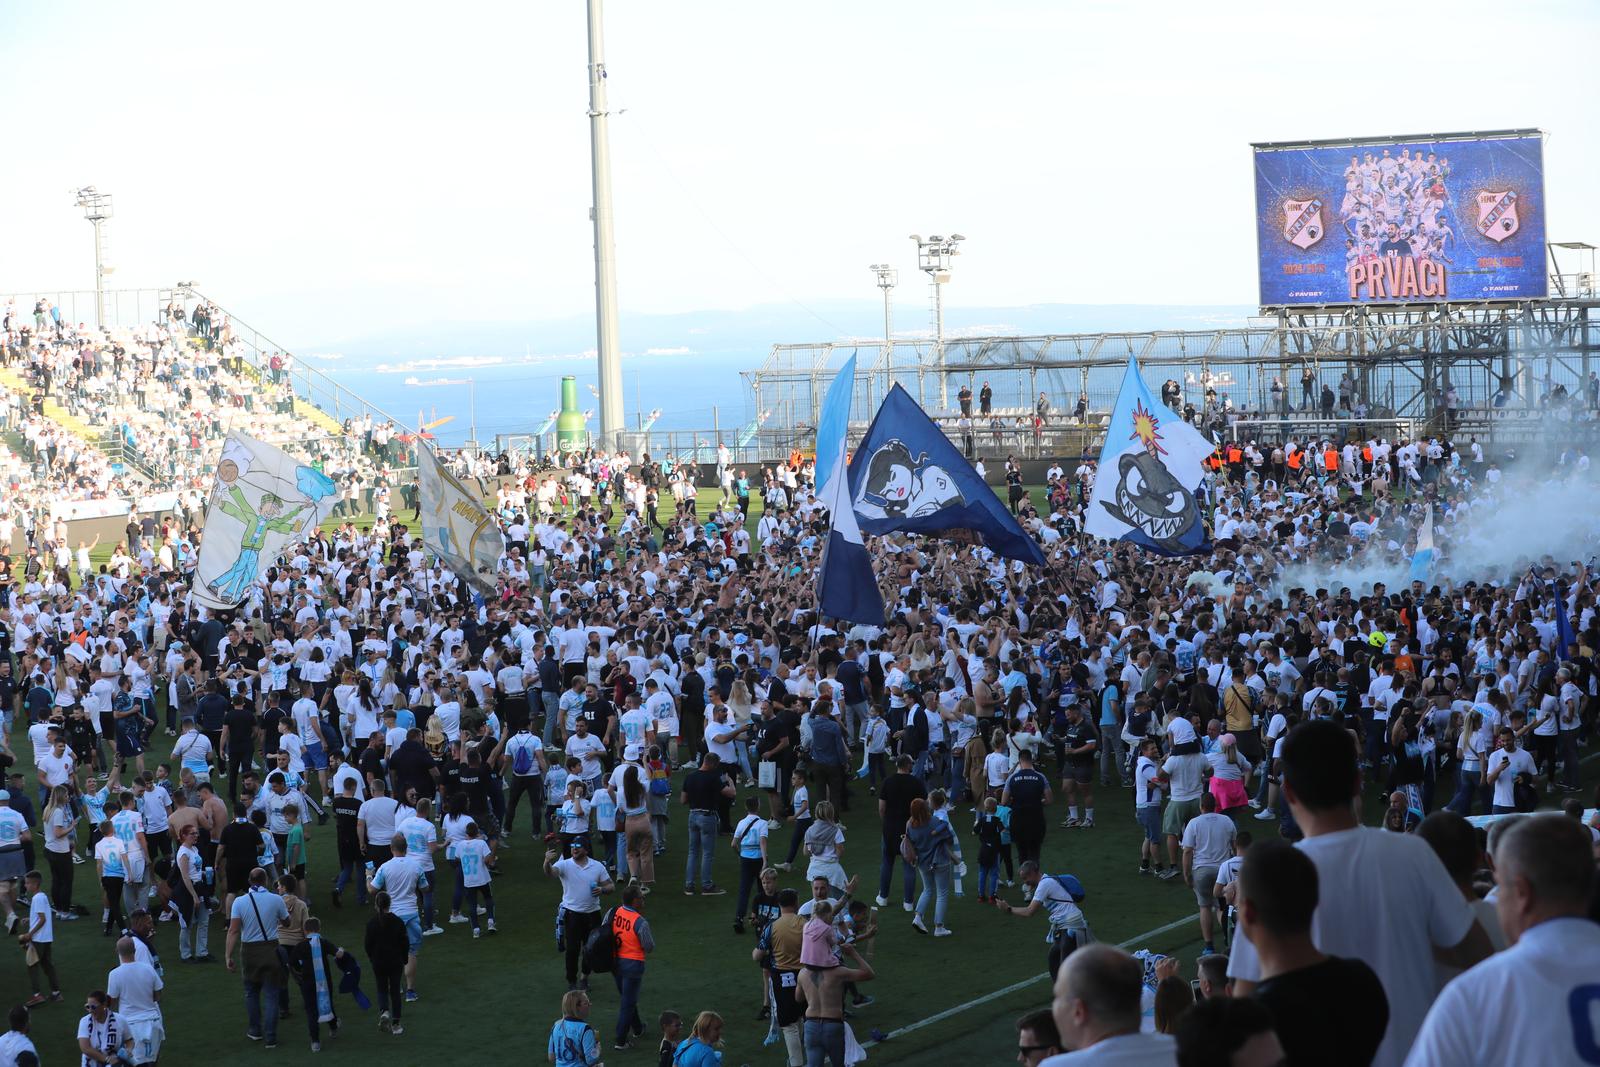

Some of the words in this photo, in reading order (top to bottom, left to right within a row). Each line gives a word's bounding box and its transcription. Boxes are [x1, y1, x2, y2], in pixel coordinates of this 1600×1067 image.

[1287, 203, 1303, 212] HNK
[1481, 195, 1497, 203] HNK
[1289, 204, 1319, 237] RIJEKA
[1481, 195, 1514, 229] RIJEKA
[1350, 256, 1446, 298] PRVACI
[325, 647, 333, 660] 9
[462, 854, 479, 875] 87
[557, 1037, 577, 1061] 18
